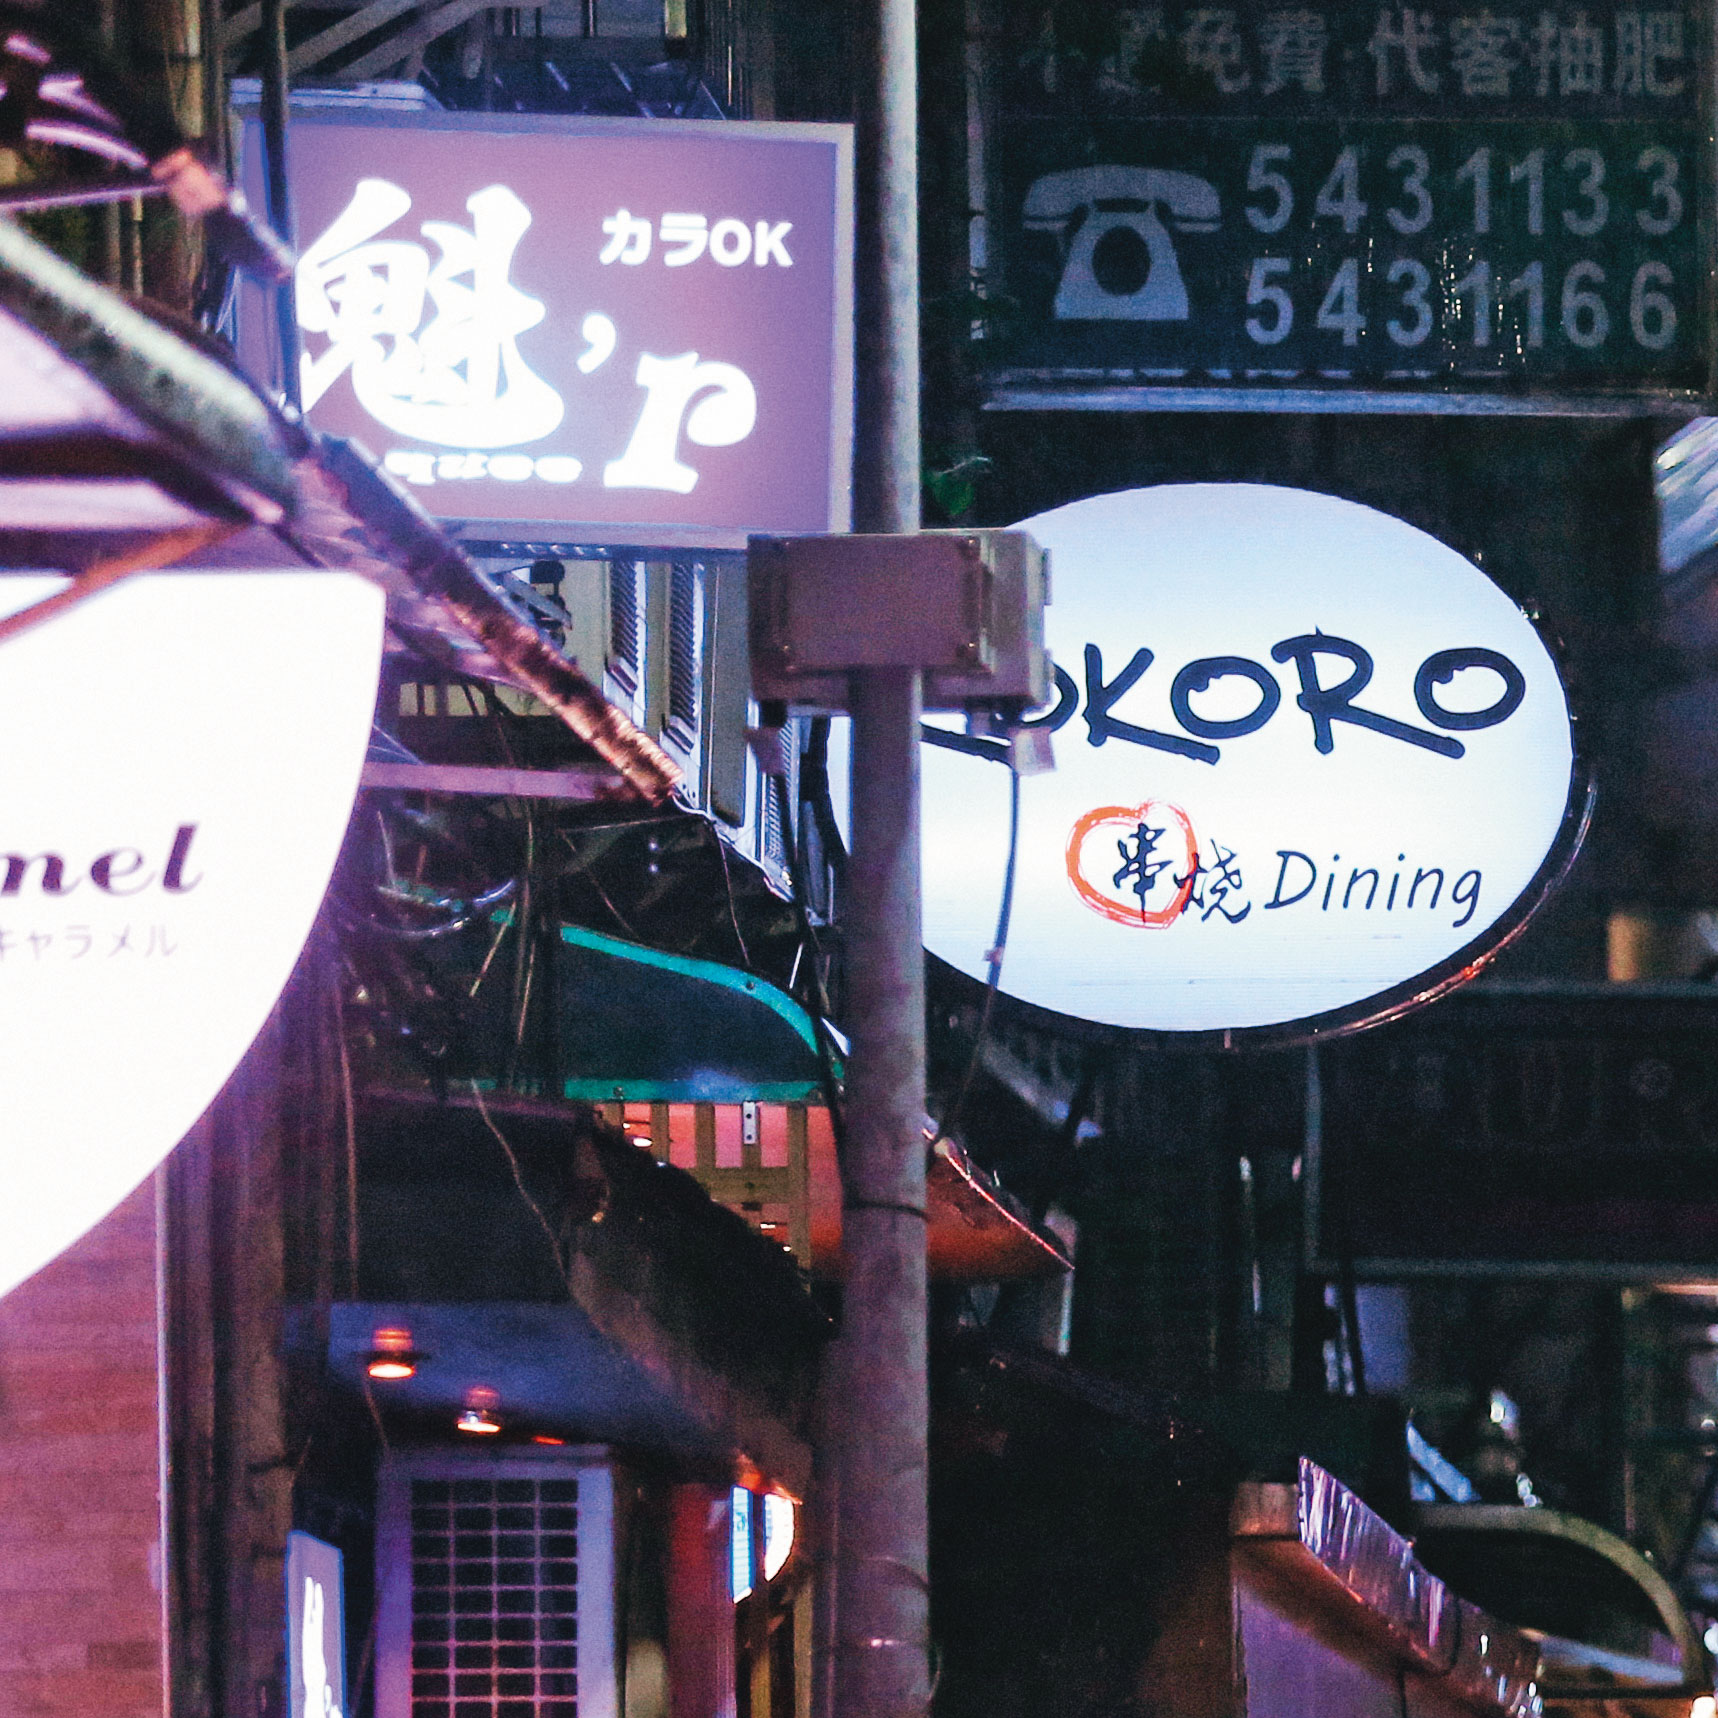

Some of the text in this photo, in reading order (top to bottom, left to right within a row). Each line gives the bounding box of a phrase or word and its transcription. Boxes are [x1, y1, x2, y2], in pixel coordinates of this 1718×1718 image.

[1244, 144, 1683, 236] 5431133
[599, 209, 794, 269] カラOK
[1244, 257, 1679, 348] 5431166
[922, 628, 1527, 765] KORO
[1264, 850, 1483, 928] Dining
